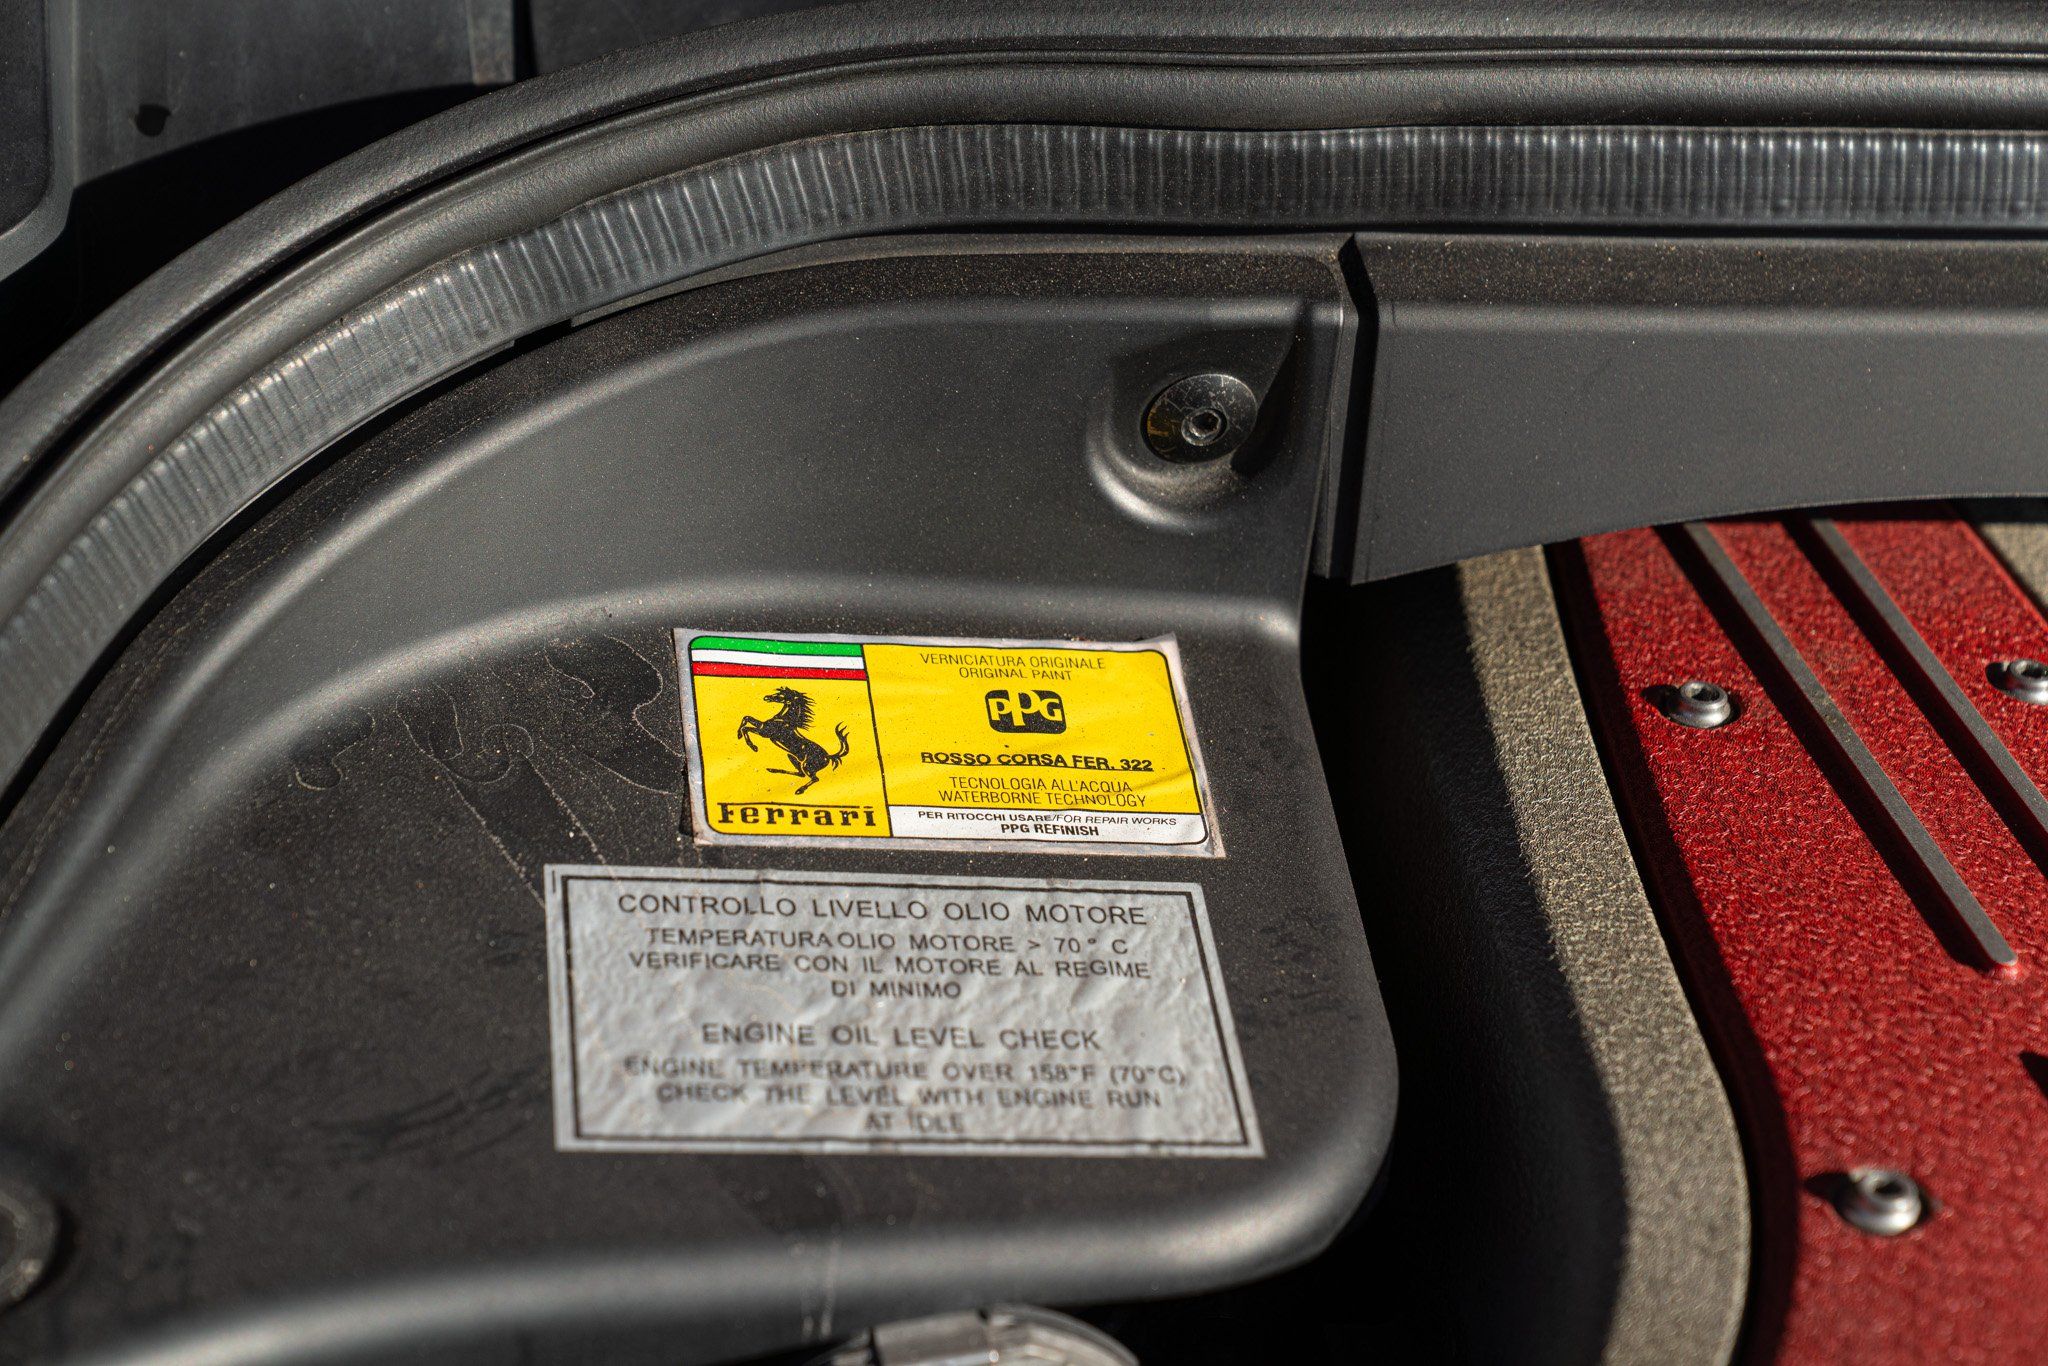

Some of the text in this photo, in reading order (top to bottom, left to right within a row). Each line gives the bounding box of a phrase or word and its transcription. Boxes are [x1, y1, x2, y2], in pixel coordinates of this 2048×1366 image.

[920, 653, 1106, 669] VERNICIATURA ORIGINALE
[960, 668, 1072, 680] ORIGINAL PAINT
[988, 690, 1063, 726] PPG
[921, 752, 1153, 771] ROSSO CORSA FER. 322
[949, 776, 1132, 793] TECNOLOGIA ALL'ACQUA
[938, 790, 1146, 807] WATERBORNE TECHNOLOGY
[717, 802, 876, 826] Ferrari
[918, 811, 944, 820] PER
[947, 812, 1005, 821] RITOCCHI
[1086, 815, 1129, 824] REPAIR
[1132, 816, 1177, 826] WORKS
[1001, 823, 1099, 836] PPG REFINISH
[618, 894, 1148, 925] CONTROLLO LIVELLO OLIO MOTORE
[645, 927, 833, 948] TEMPERATURA
[837, 932, 895, 949] OLIO
[909, 934, 1015, 951] MOTORE
[628, 951, 1152, 979] VERIFICARE CON IL MOTORE AL REGIME
[831, 980, 961, 999] DI MINIMO
[702, 1022, 1102, 1050] ENGINE OIL LEVEL CHECK
[624, 1054, 724, 1080] ENGINE
[737, 1057, 928, 1082] TEMPERATURE
[942, 1062, 1014, 1082] OVER
[657, 1082, 1162, 1108] CHECK THE LEVEL WITH ENGINE RUN
[864, 1112, 894, 1132] AT
